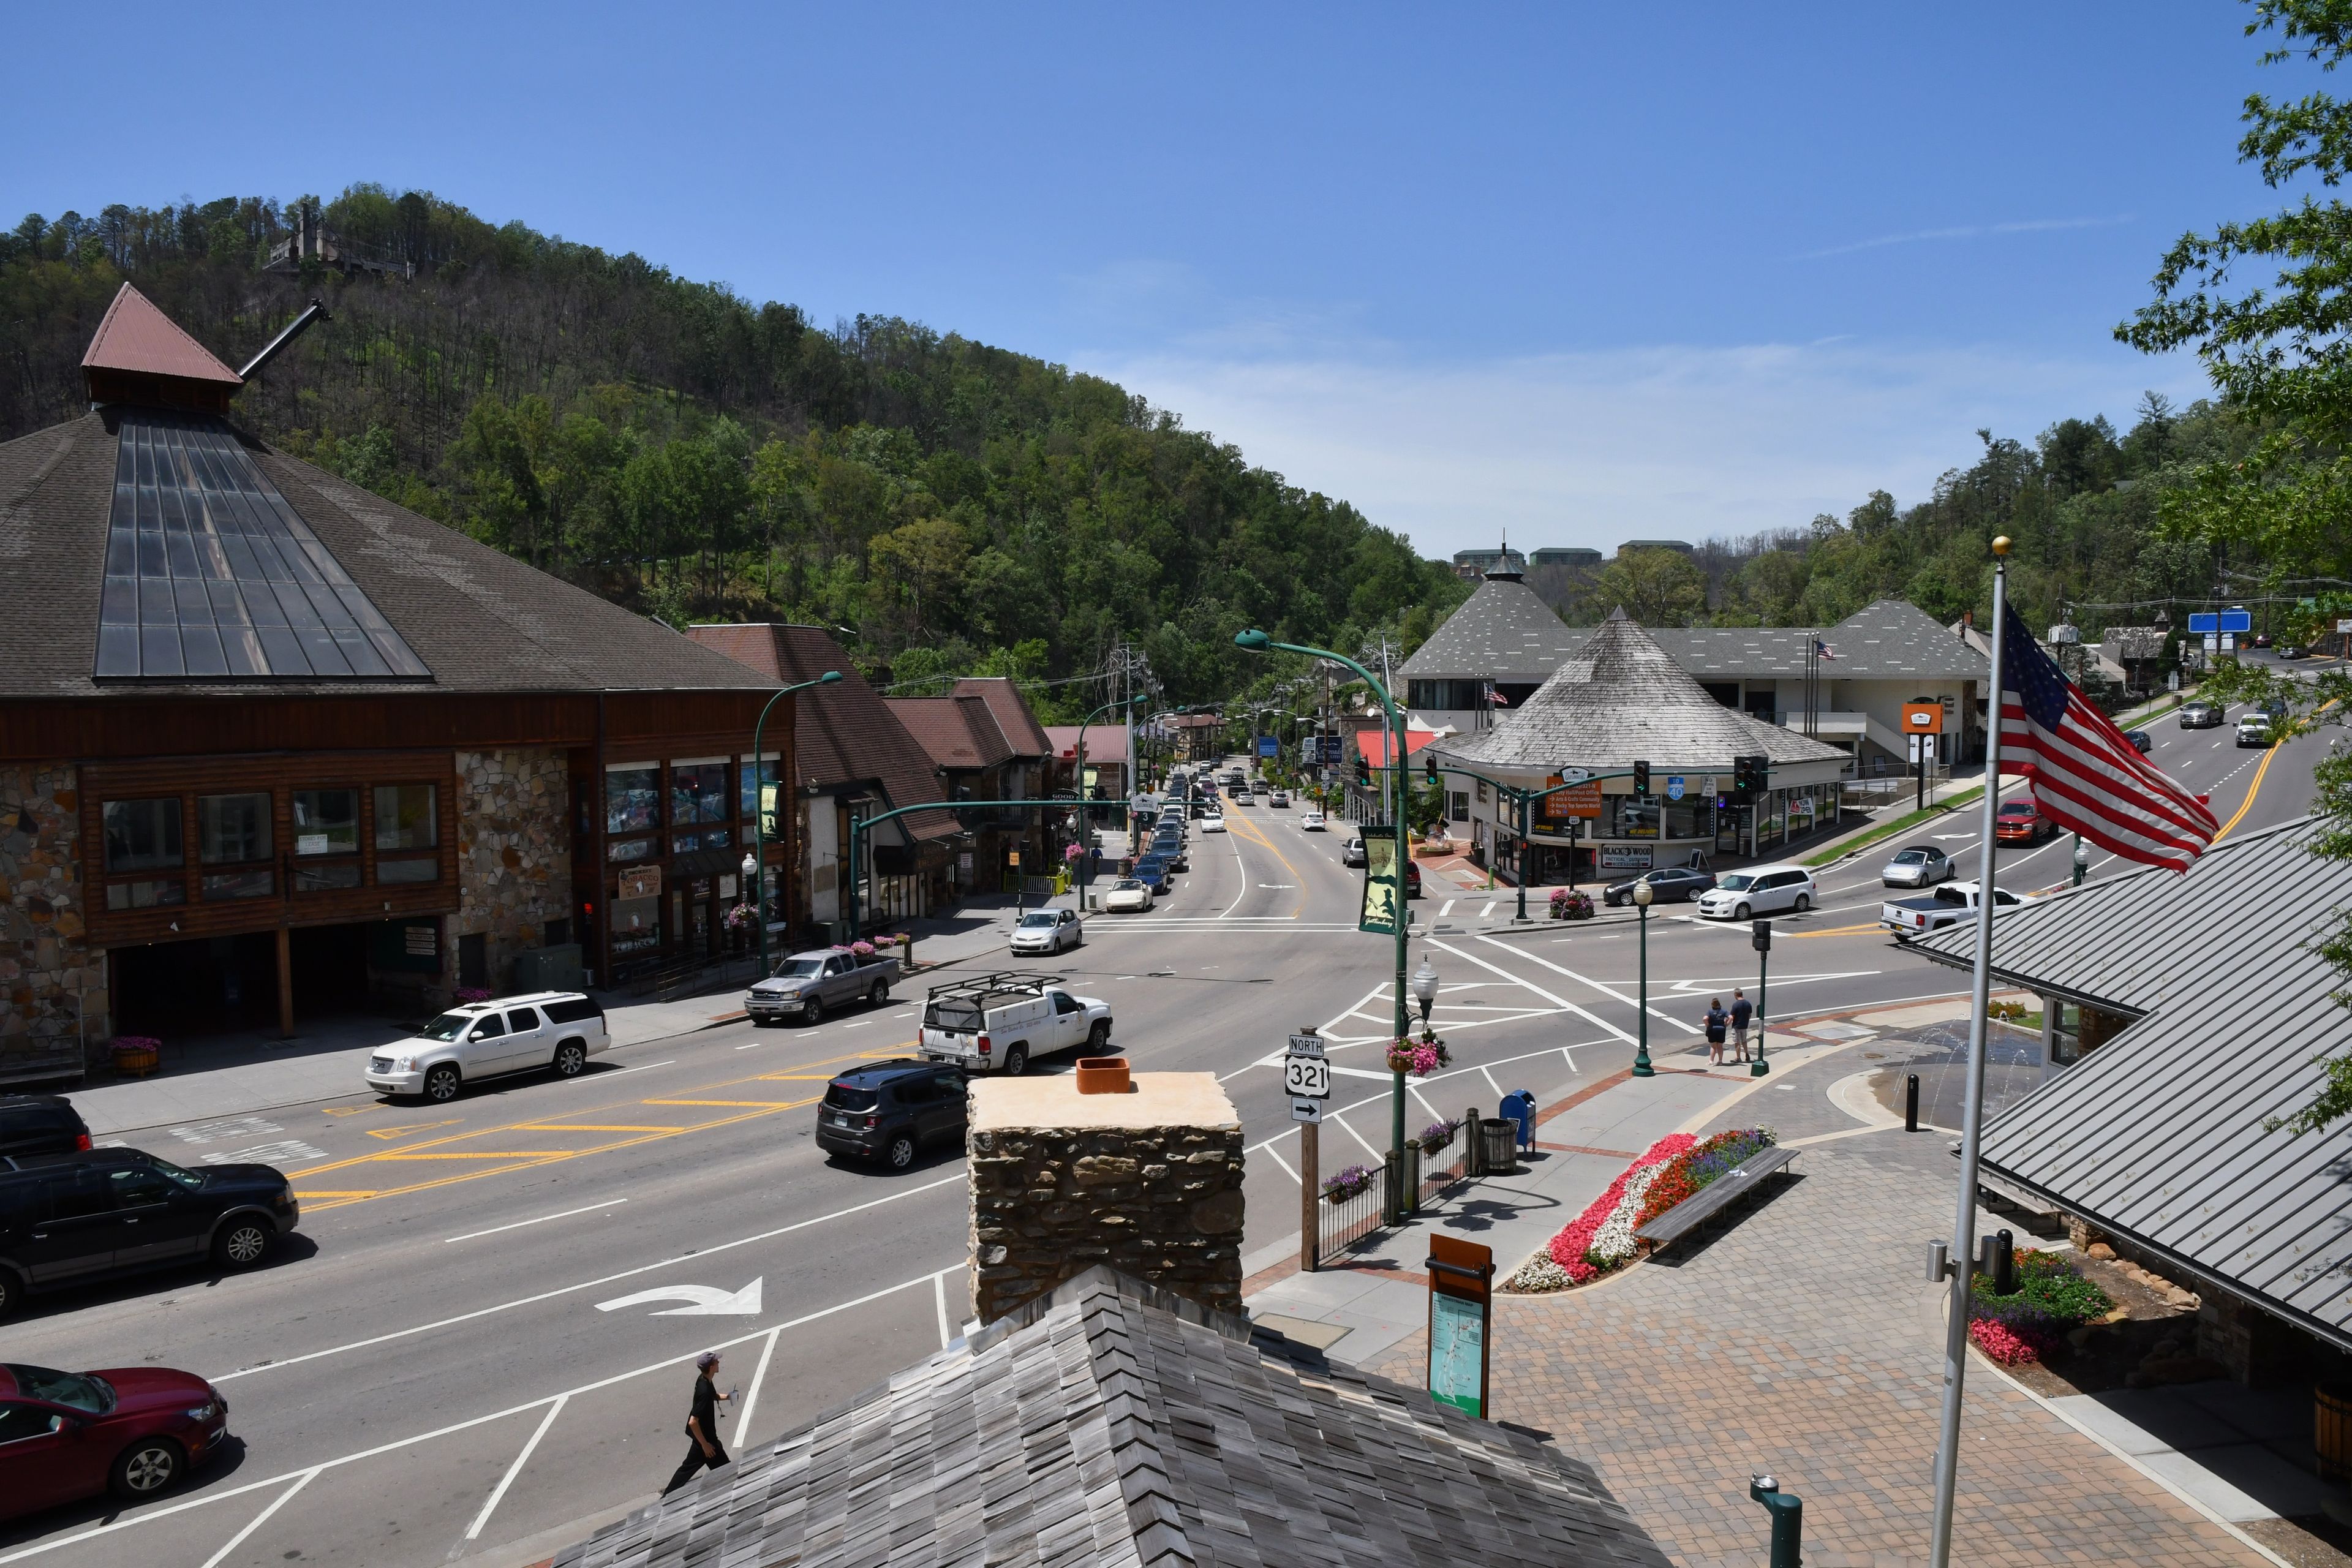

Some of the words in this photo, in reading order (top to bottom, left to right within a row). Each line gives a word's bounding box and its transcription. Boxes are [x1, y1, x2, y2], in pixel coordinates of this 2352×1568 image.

[1670, 788, 1683, 797] 40
[1142, 812, 1148, 821] 3
[1632, 847, 1651, 856] WOOD
[621, 875, 659, 887] TOBACCO
[1365, 917, 1393, 929] Gatlinburg
[614, 937, 656, 951] TOBACCO
[1291, 1038, 1322, 1053] NORTH
[1291, 1064, 1325, 1088] 321
[1441, 1295, 1464, 1305] PEDESTRIAN
